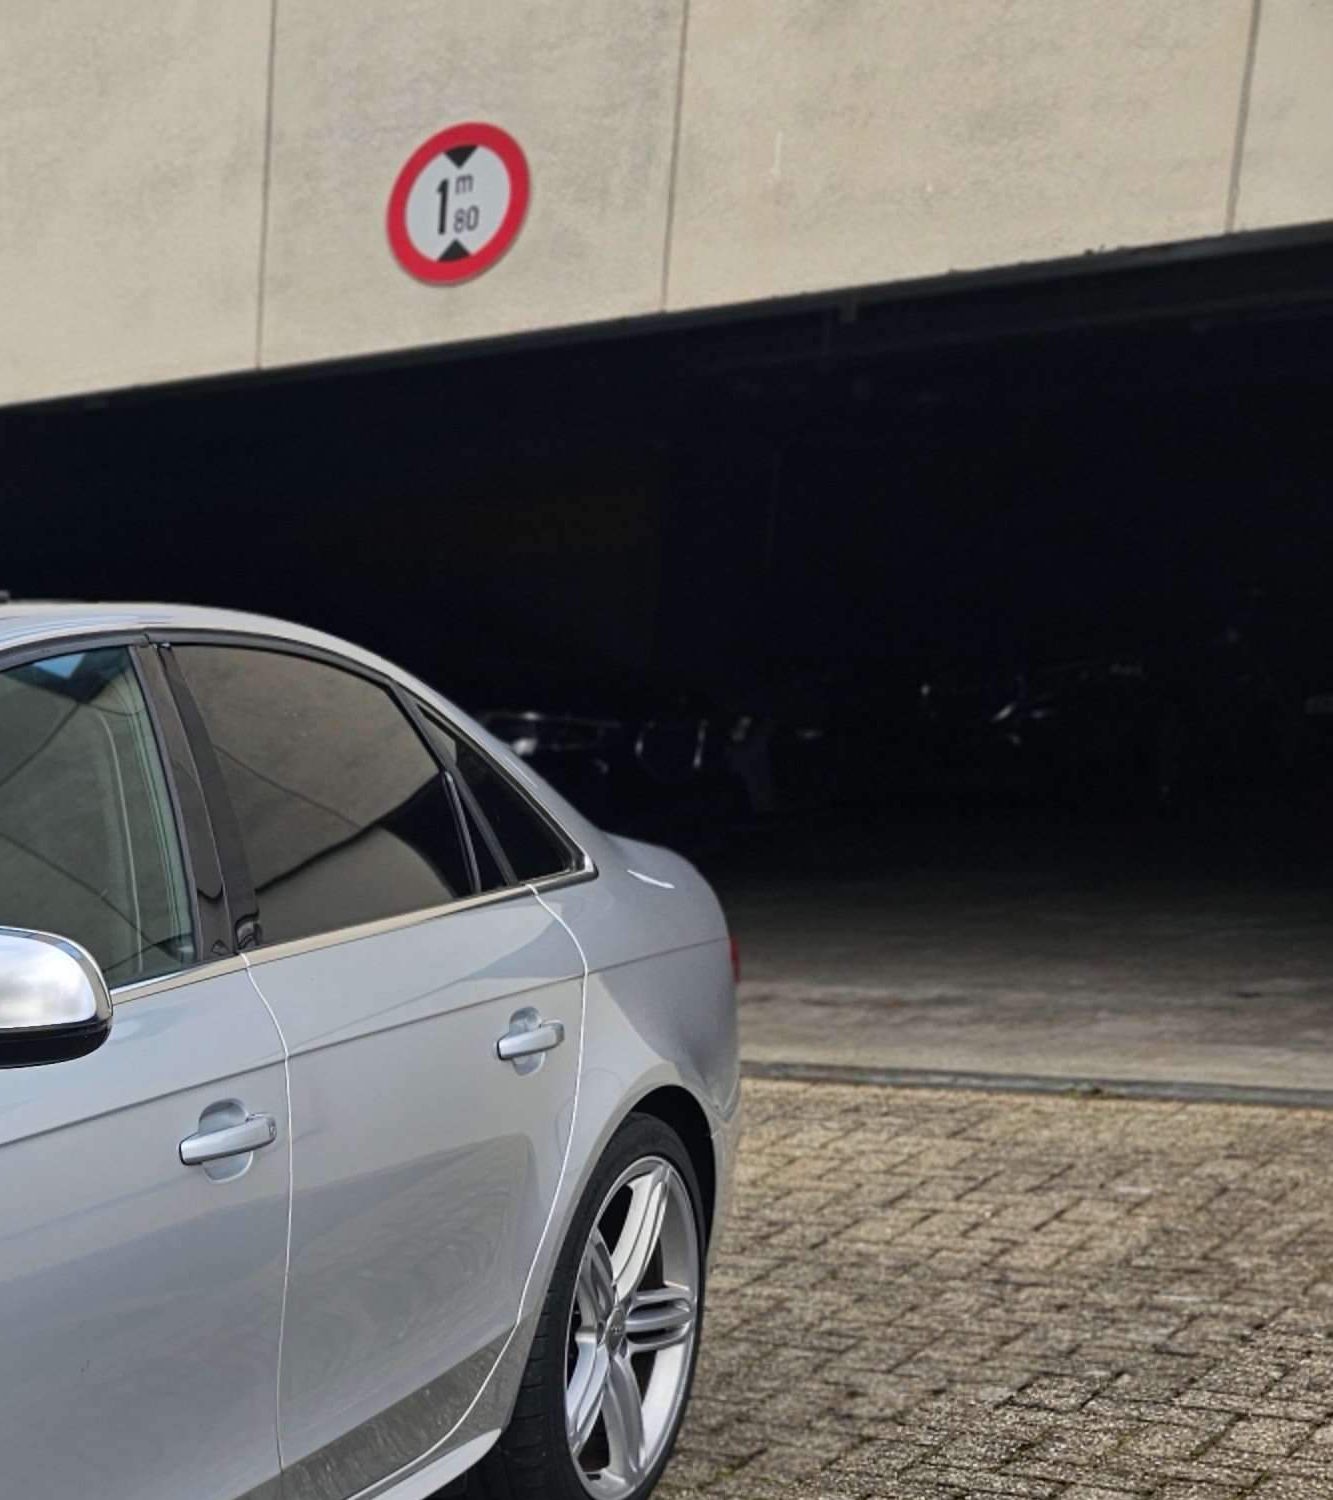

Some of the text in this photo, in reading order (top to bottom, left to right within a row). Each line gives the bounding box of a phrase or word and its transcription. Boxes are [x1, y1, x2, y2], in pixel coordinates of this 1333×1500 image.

[436, 174, 474, 235] 1 m
[452, 204, 480, 233] 80
